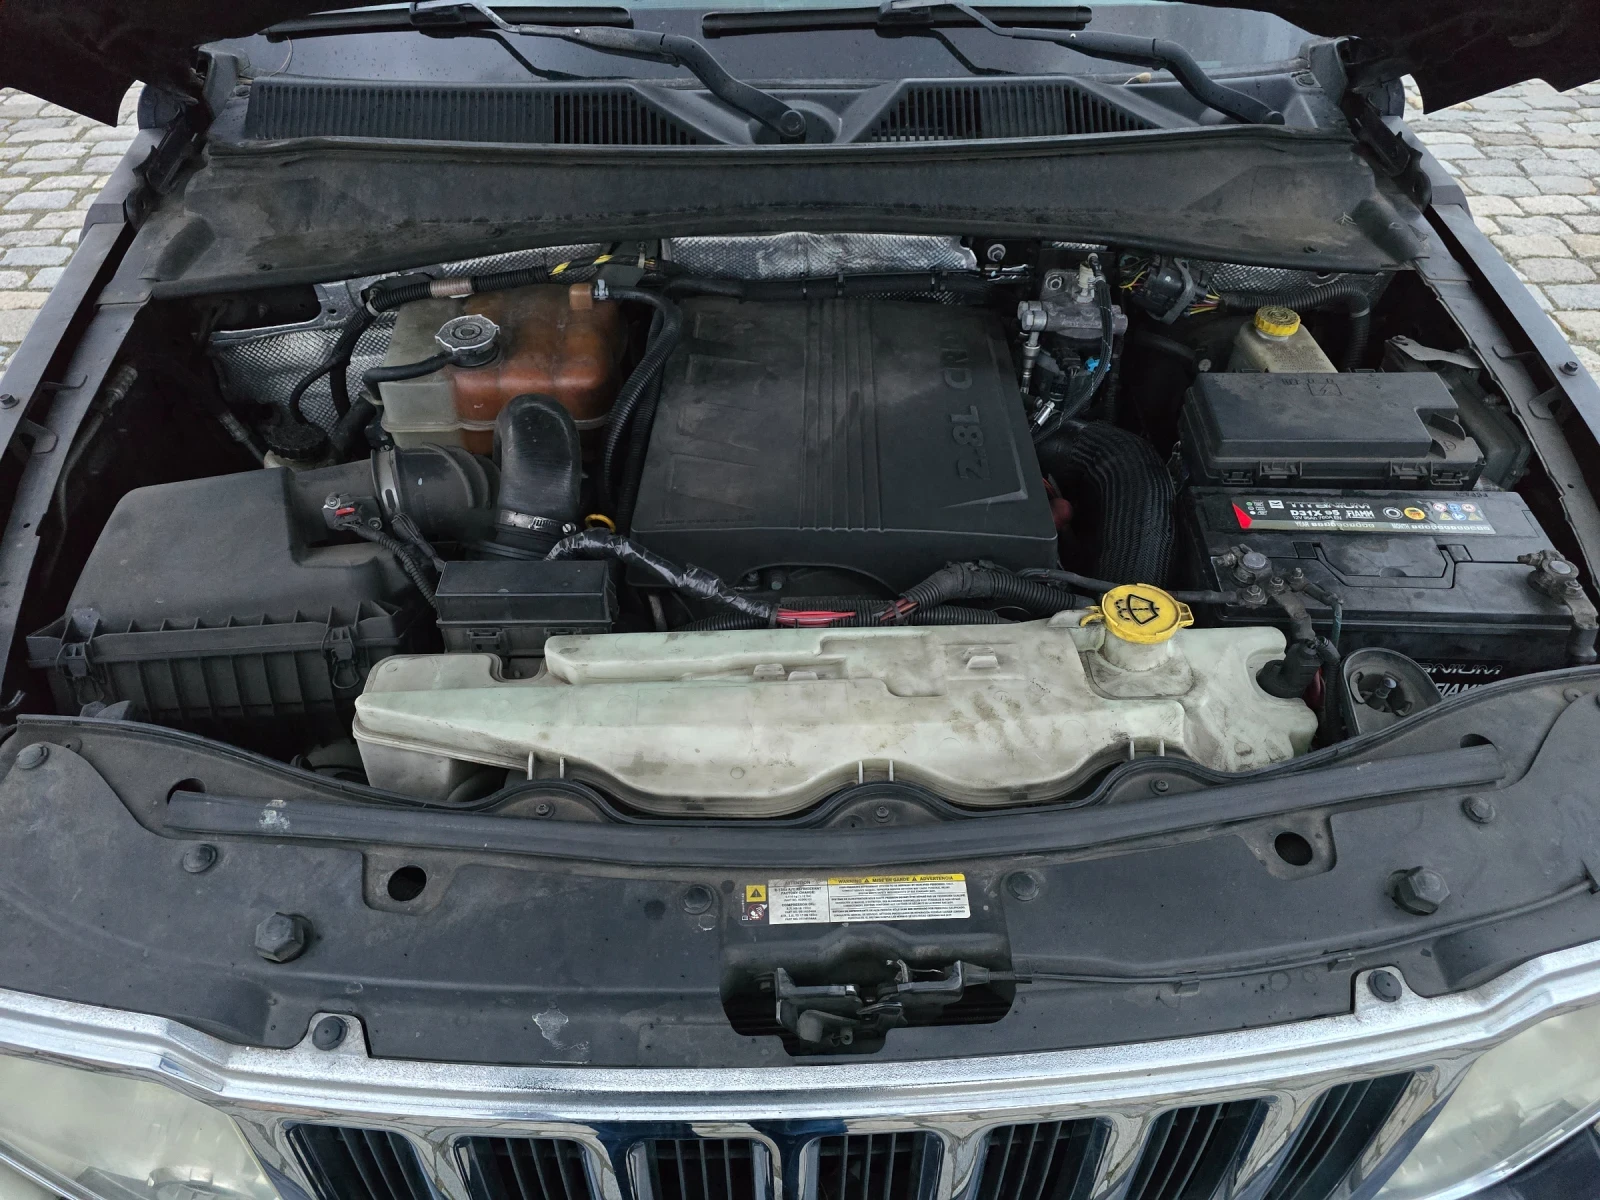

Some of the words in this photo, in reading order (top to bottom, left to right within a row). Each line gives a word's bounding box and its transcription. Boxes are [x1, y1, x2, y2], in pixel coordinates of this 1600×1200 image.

[951, 405, 991, 480] 2.8L
[1346, 510, 1375, 519] FIAMM
[1419, 662, 1503, 675] ANIUM
